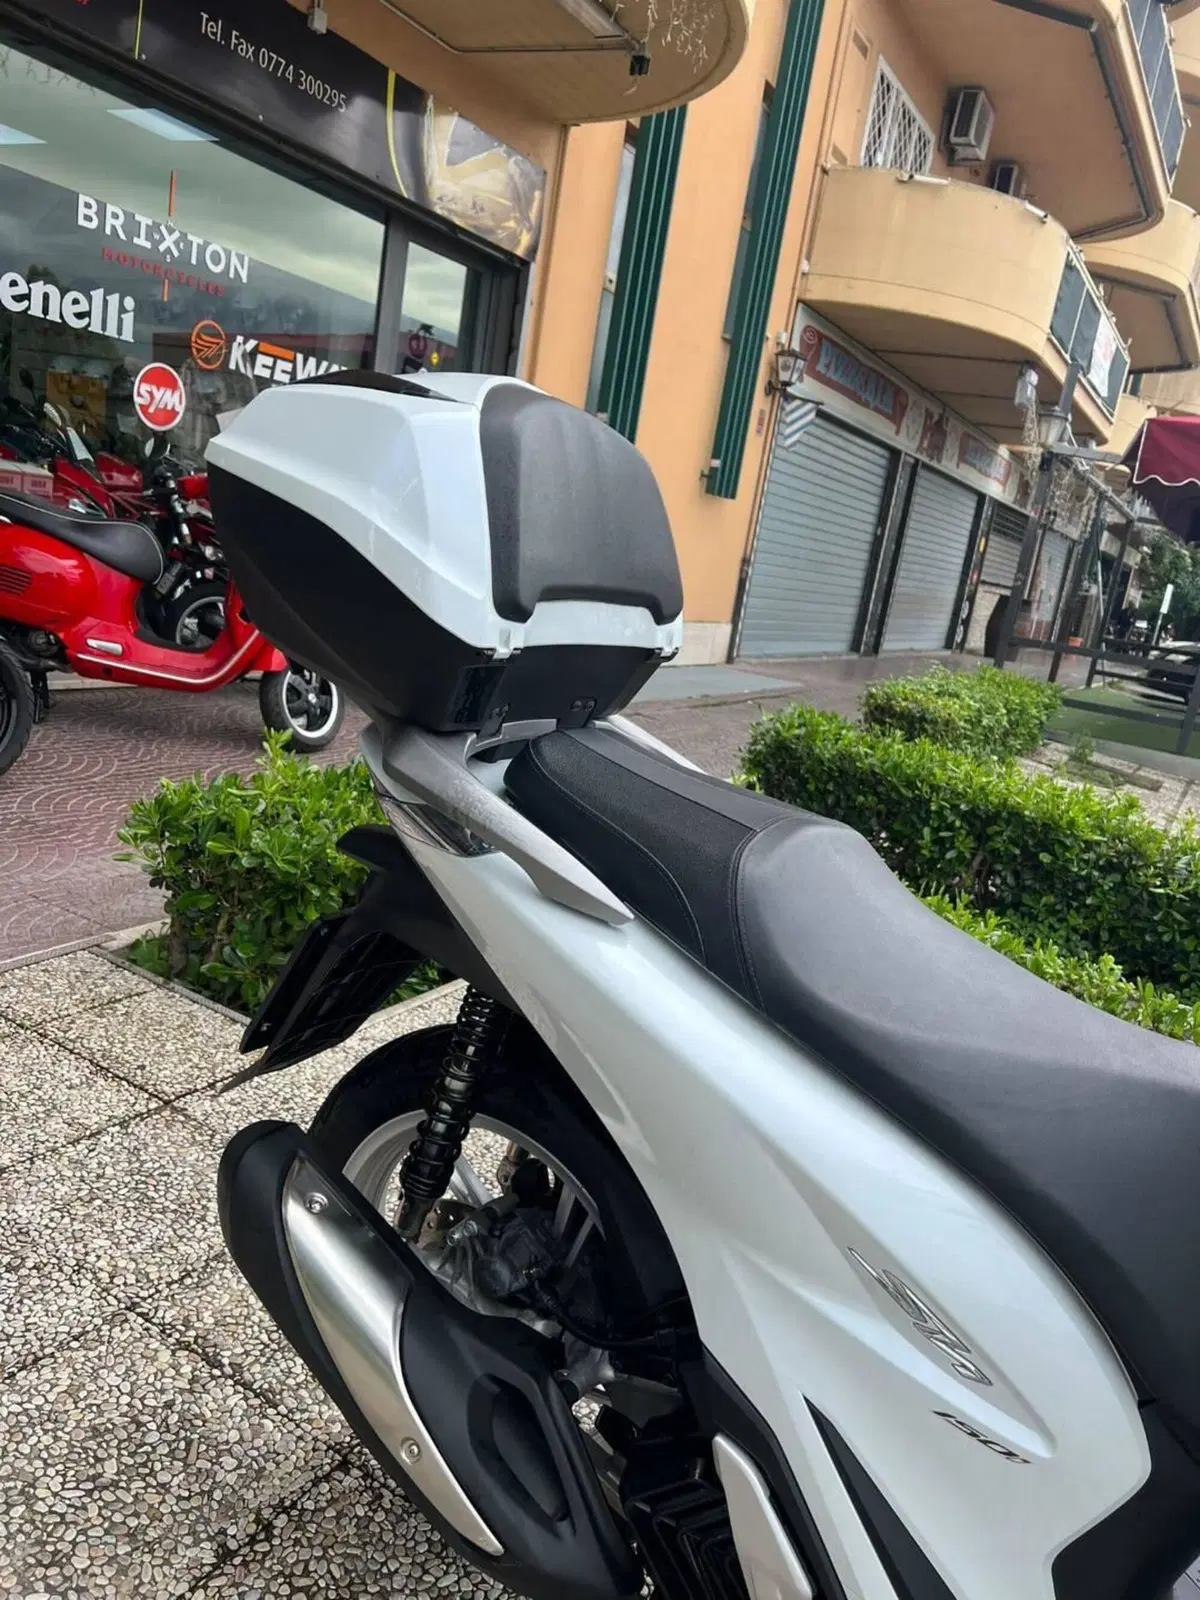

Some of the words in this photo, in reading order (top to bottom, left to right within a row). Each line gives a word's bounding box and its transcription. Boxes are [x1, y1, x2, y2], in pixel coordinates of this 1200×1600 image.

[200, 12, 225, 45] Tel.
[230, 30, 255, 62] Fax
[259, 48, 294, 83] 0774
[298, 69, 347, 113] 300295
[77, 193, 249, 284] BRIXTON
[136, 383, 183, 413] SYM
